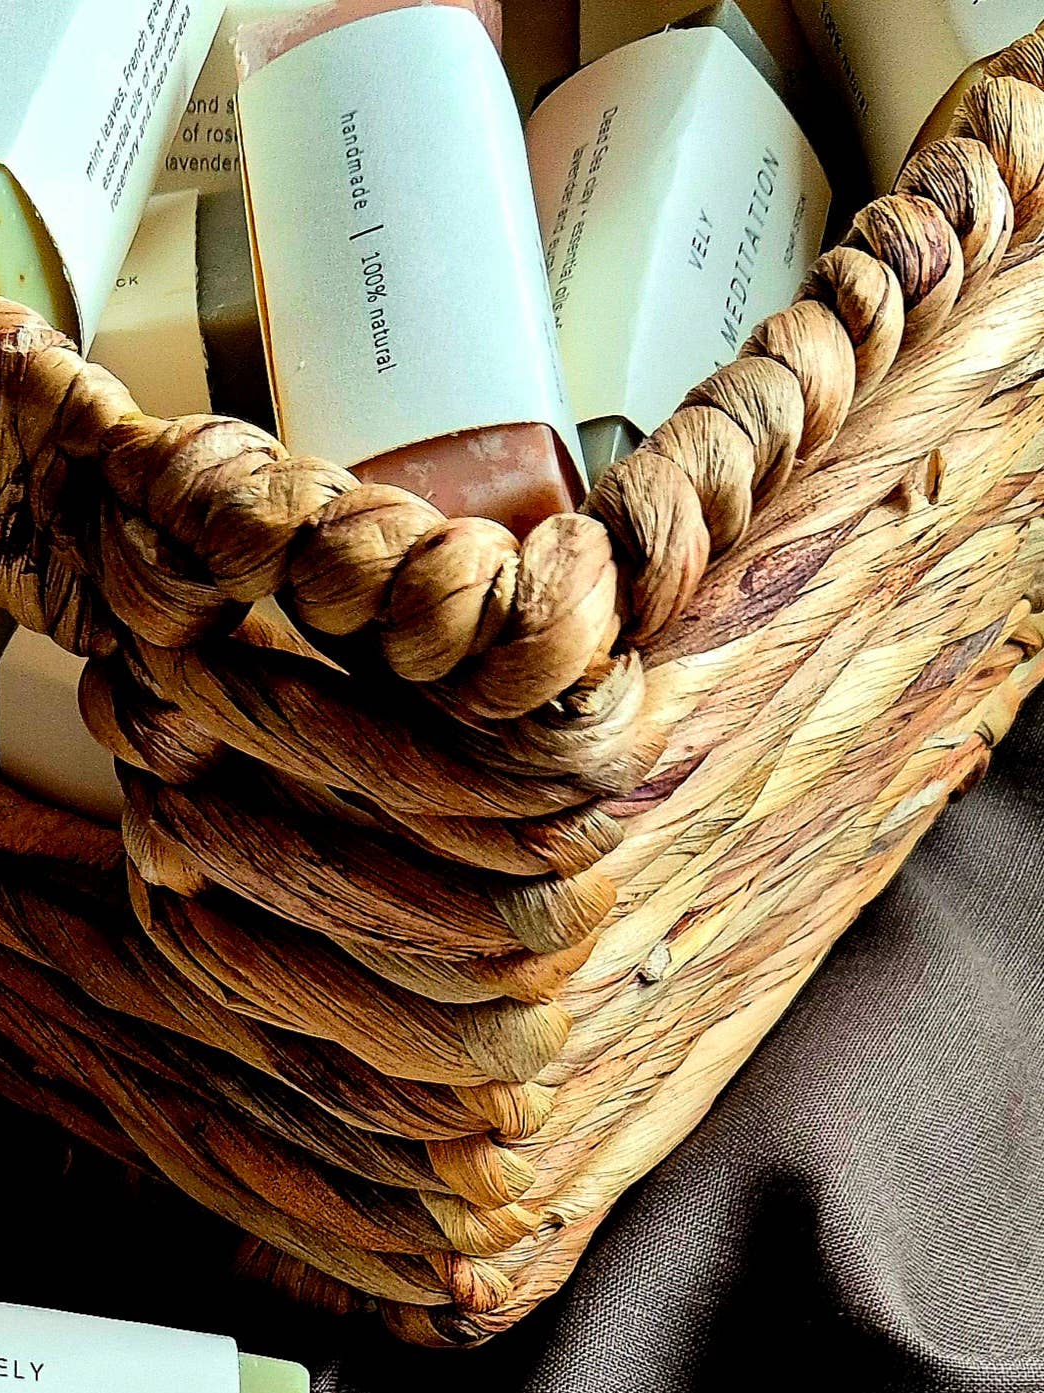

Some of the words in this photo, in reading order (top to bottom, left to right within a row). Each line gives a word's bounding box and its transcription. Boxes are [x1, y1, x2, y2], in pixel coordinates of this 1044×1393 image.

[206, 127, 238, 143] ros
[341, 111, 370, 210] handmade
[689, 208, 712, 270] VELY
[721, 148, 779, 351] MEDITATION
[361, 252, 387, 303] 100%
[369, 308, 397, 374] natural
